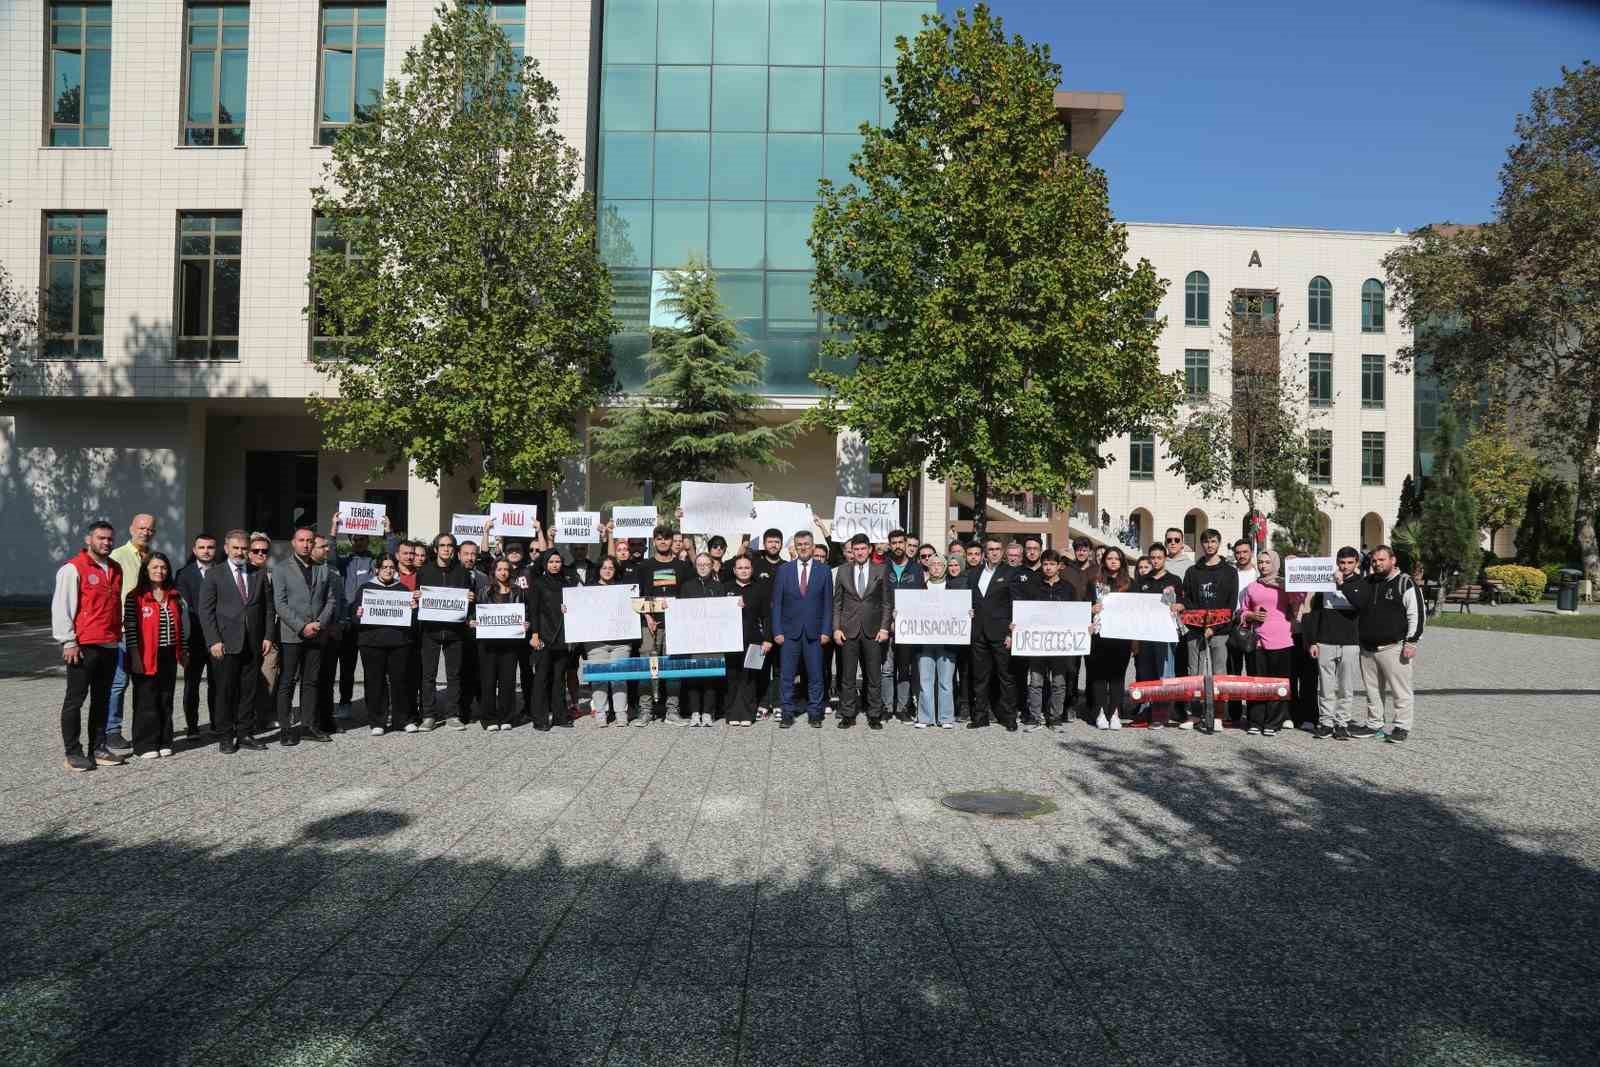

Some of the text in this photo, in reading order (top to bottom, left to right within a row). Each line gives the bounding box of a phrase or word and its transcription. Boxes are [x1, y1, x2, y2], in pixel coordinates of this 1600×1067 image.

[1248, 250, 1262, 267] A
[350, 507, 375, 518] TERÖRE
[502, 510, 524, 526] MİLLİ
